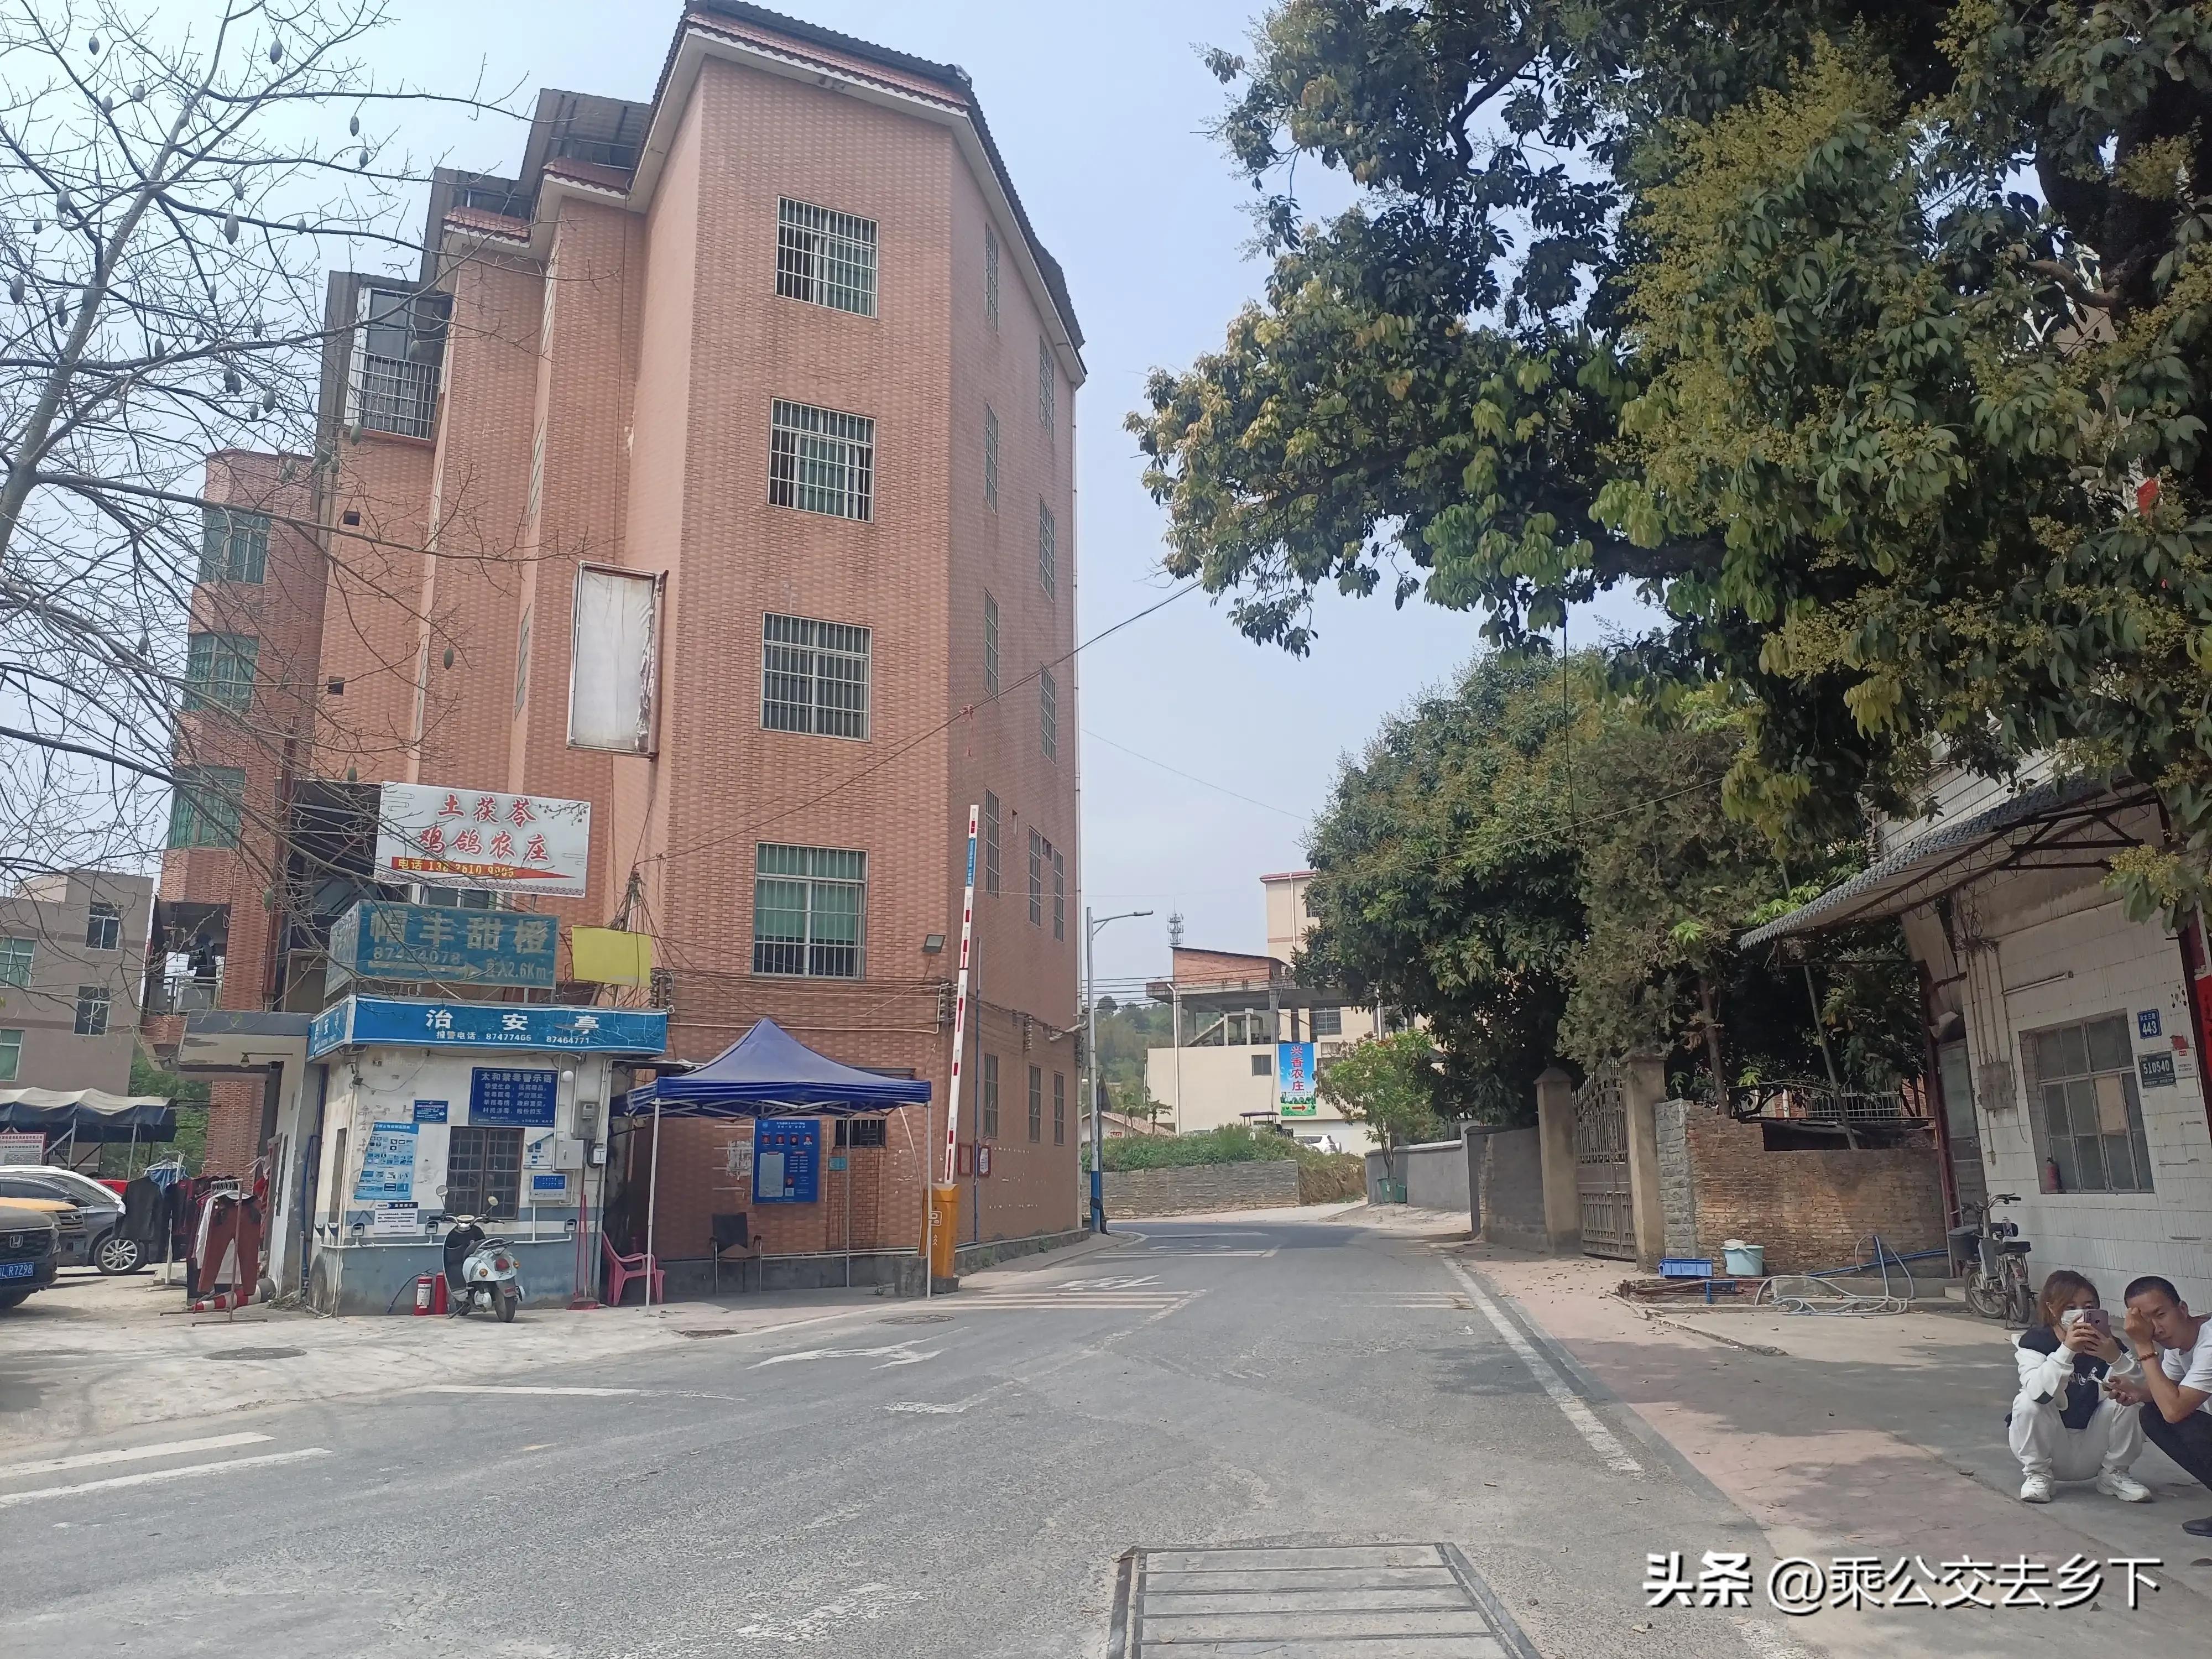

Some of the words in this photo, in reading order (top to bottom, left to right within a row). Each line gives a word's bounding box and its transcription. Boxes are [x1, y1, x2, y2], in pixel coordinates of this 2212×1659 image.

[437, 792, 537, 828] 土茯苓
[418, 826, 549, 861] 鸡鸽农庄
[398, 858, 424, 870] 电话
[425, 1009, 599, 1034] 治安亭
[2142, 1021, 2157, 1035] 443
[546, 1036, 590, 1045] 87464771
[1291, 1044, 1305, 1092] 兴香农庄
[2143, 1059, 2171, 1074] 510540
